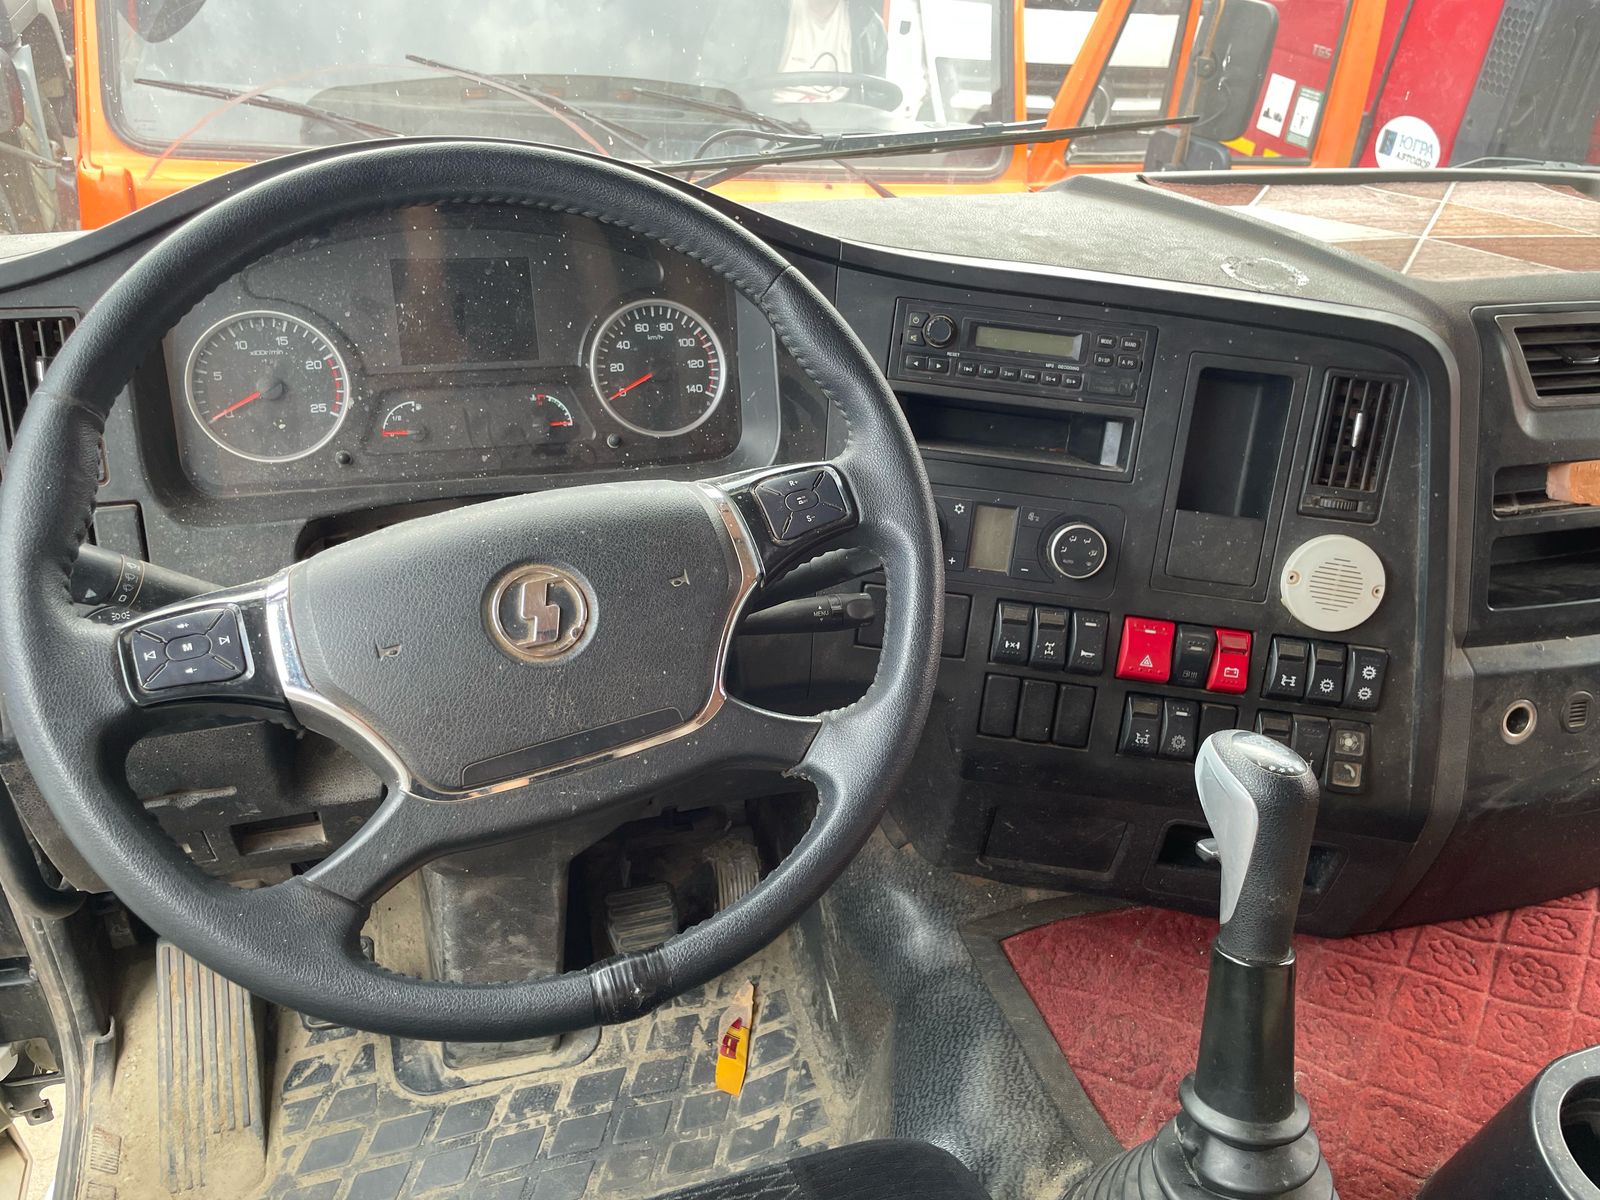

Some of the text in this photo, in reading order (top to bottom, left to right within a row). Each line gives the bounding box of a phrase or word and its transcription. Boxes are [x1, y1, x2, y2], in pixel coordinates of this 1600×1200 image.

[1400, 135, 1433, 158] ЮГРА
[635, 323, 649, 333] 60
[659, 322, 674, 332] 80
[234, 340, 248, 350] 10
[275, 336, 289, 346] 15
[616, 340, 631, 350] 40
[678, 338, 696, 347] 100
[1100, 338, 1113, 346] MODE
[305, 360, 323, 370] 20
[609, 362, 625, 372] 20
[687, 359, 705, 369] 120
[213, 371, 222, 381] 5
[686, 384, 704, 393] 140
[310, 403, 327, 413] 25
[182, 642, 193, 652] M
